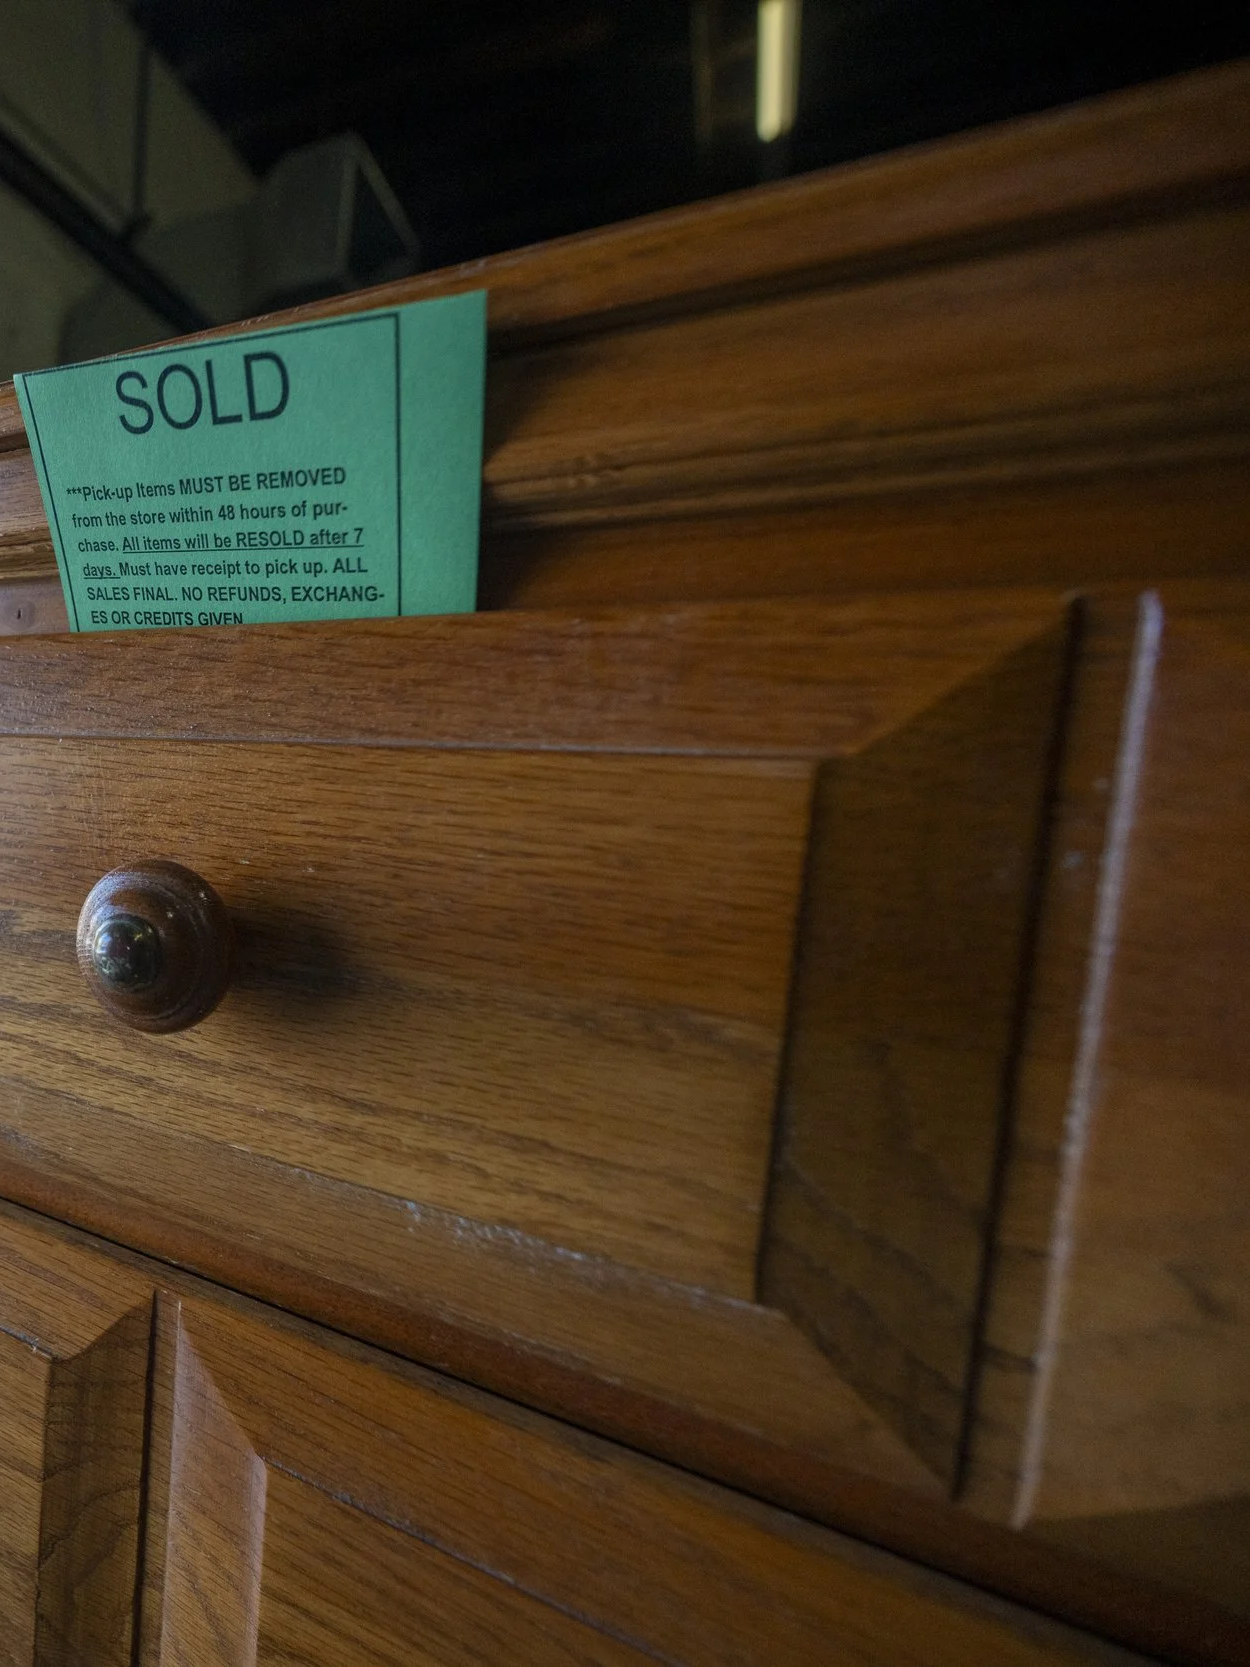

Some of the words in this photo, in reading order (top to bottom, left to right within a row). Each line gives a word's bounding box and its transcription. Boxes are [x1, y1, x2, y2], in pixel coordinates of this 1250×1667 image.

[116, 351, 290, 434] SOLD
[136, 482, 176, 498] Items
[179, 476, 224, 495] MUST
[228, 474, 251, 492] BE
[256, 467, 347, 490] REMOVED
[72, 513, 103, 528] from
[105, 511, 127, 526] the
[130, 510, 166, 525] store
[169, 506, 213, 523] within
[218, 504, 236, 520] 48
[240, 504, 286, 520] hours
[291, 500, 307, 517] of
[313, 502, 348, 520] pur-
[78, 538, 119, 552] chase.
[122, 536, 140, 551] All
[143, 535, 181, 550] items
[184, 533, 209, 549] will
[213, 532, 232, 548] be
[236, 529, 305, 547] RESOLD
[310, 528, 349, 546] after
[353, 527, 364, 544] 7
[83, 563, 116, 578] days.
[119, 562, 151, 577] Must
[154, 561, 187, 576] have
[192, 560, 241, 578] receipt
[244, 560, 260, 575] to
[265, 559, 299, 578] pick
[303, 561, 328, 578] up.
[332, 557, 368, 574] ALL
[87, 586, 129, 601] SALES
[133, 586, 178, 601] FINAL.
[182, 586, 203, 601] NO
[207, 586, 286, 604] REFUNDS,
[291, 585, 385, 602] EXCHANG-
[91, 611, 108, 624] ES
[111, 611, 131, 625] OR
[134, 611, 194, 626] CREDITS
